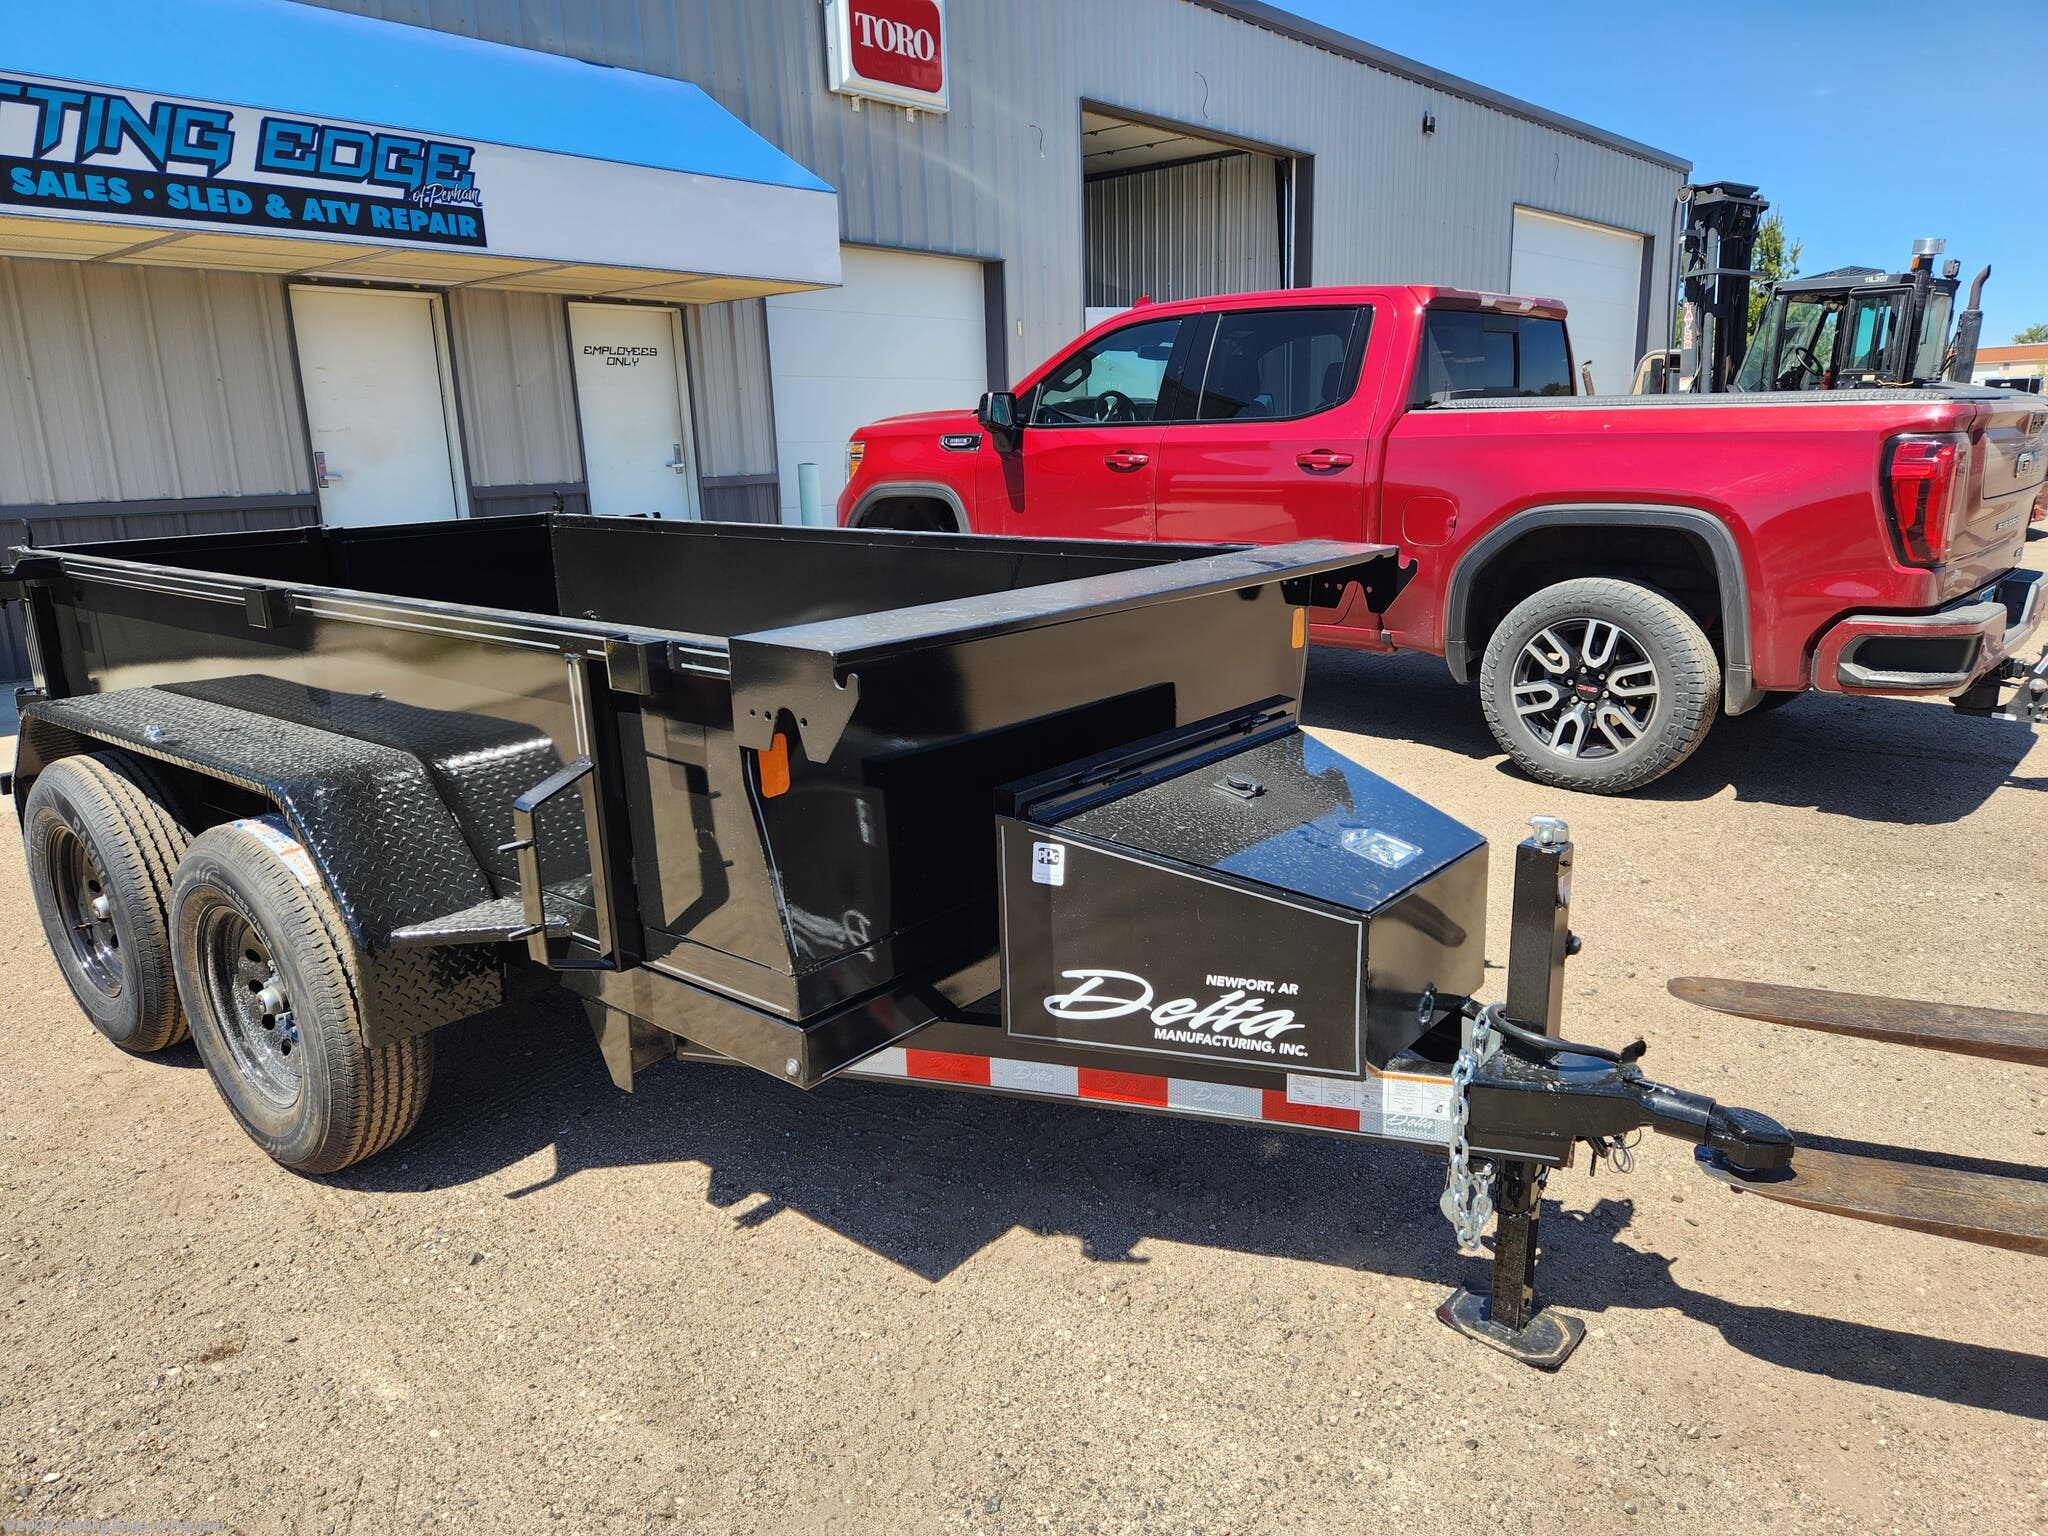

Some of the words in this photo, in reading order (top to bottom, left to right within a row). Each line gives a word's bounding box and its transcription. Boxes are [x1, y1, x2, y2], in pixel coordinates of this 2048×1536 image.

[855, 11, 935, 61] TORO
[255, 117, 476, 193] EDGE
[10, 166, 132, 205] SALES
[166, 183, 253, 215] SLED
[264, 194, 293, 219] &
[302, 198, 360, 226] ATV
[370, 205, 478, 238] REPAIR
[412, 185, 427, 209] of
[426, 182, 482, 208] Perham
[583, 345, 658, 357] EMPLOYEES
[606, 356, 640, 367] ONLY
[1038, 848, 1060, 864] PPG
[1205, 974, 1275, 995] NEWPORT,
[1278, 982, 1300, 995] AR
[1043, 968, 1306, 1040] Delta
[1153, 1027, 1276, 1055] MANUFACTURING,
[1279, 1042, 1309, 1057] INC.
